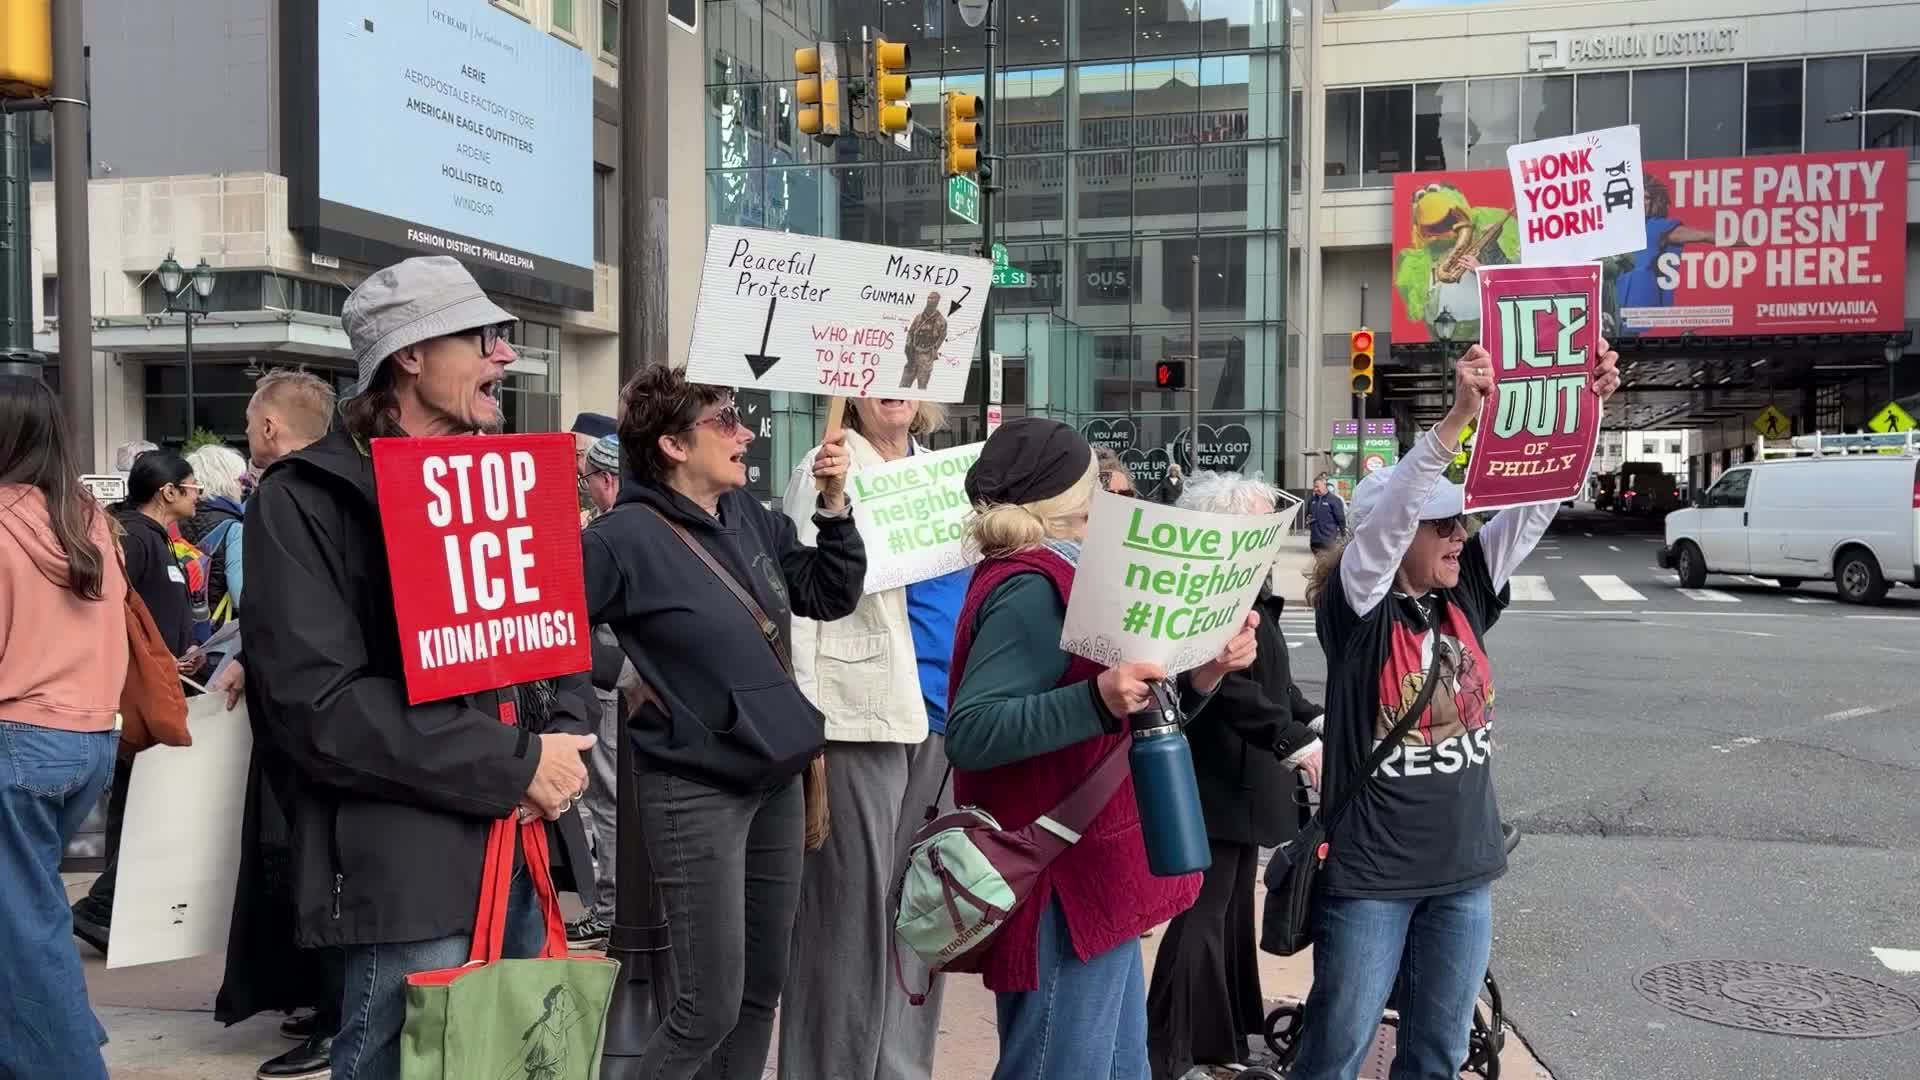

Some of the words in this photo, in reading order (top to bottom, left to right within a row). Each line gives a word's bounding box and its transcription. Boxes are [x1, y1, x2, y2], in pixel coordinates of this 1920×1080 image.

[1569, 34, 1647, 62] FASHION
[1656, 28, 1740, 57] DISTRICT
[461, 64, 486, 84] AERIE
[404, 68, 469, 104] AEROPOSTALE
[471, 94, 508, 119] FACTORY
[509, 110, 535, 130] STORE
[406, 97, 454, 125] AMERICAN
[456, 115, 484, 136] EAGLE
[485, 127, 533, 154] OUTFITTERS
[456, 143, 491, 165] ARDENE
[1520, 148, 1594, 184] HONK
[441, 163, 488, 189] HOLLISTER
[490, 179, 504, 194] CO.
[1669, 167, 1743, 208] THE
[1753, 160, 1885, 205] PARTY
[453, 194, 494, 217] WINDSOR
[1523, 178, 1593, 213] YOUR
[1528, 205, 1604, 243] HORN!
[1715, 203, 1884, 247] DOESN'T
[407, 228, 445, 248] FASHION
[446, 239, 481, 257] DISTRICT
[482, 247, 535, 270] PHILADELPHIA
[728, 238, 816, 276] Peaceful
[885, 254, 959, 286] MASKED
[992, 272, 1006, 284] et
[1011, 272, 1025, 284] St
[1657, 249, 1757, 291] STOP
[1766, 245, 1882, 287] HERE.
[736, 271, 830, 302] Protester
[860, 285, 915, 305] GUNMAN
[1756, 300, 1878, 317] PENNSYLVANIA
[812, 324, 848, 342] WHO
[853, 328, 895, 350] NEEDS
[1497, 293, 1588, 371] ICE
[816, 349, 834, 362] TO
[861, 352, 880, 366] TO
[819, 368, 875, 397] JAIL?
[1493, 372, 1588, 439] OUT
[1090, 440, 1122, 449] WORTH
[1093, 431, 1111, 440] YOU
[1112, 431, 1129, 440] ARE
[1224, 442, 1250, 453] GOT
[1524, 442, 1549, 456] OF
[1129, 471, 1161, 480] STYLE
[1152, 461, 1167, 471] UR
[1197, 455, 1237, 465] HEART
[1486, 454, 1576, 477] PHILLY
[423, 451, 537, 528] STOP
[854, 467, 921, 499] Love
[872, 485, 970, 527] neighbo
[888, 519, 961, 555] #ICEo
[1127, 507, 1223, 555] Love
[1227, 520, 1283, 561] your
[444, 525, 540, 615] ICE
[1124, 561, 1263, 605] neighbor
[1123, 598, 1241, 641] #ICEout
[418, 609, 577, 670] KIDNAPPINGS!
